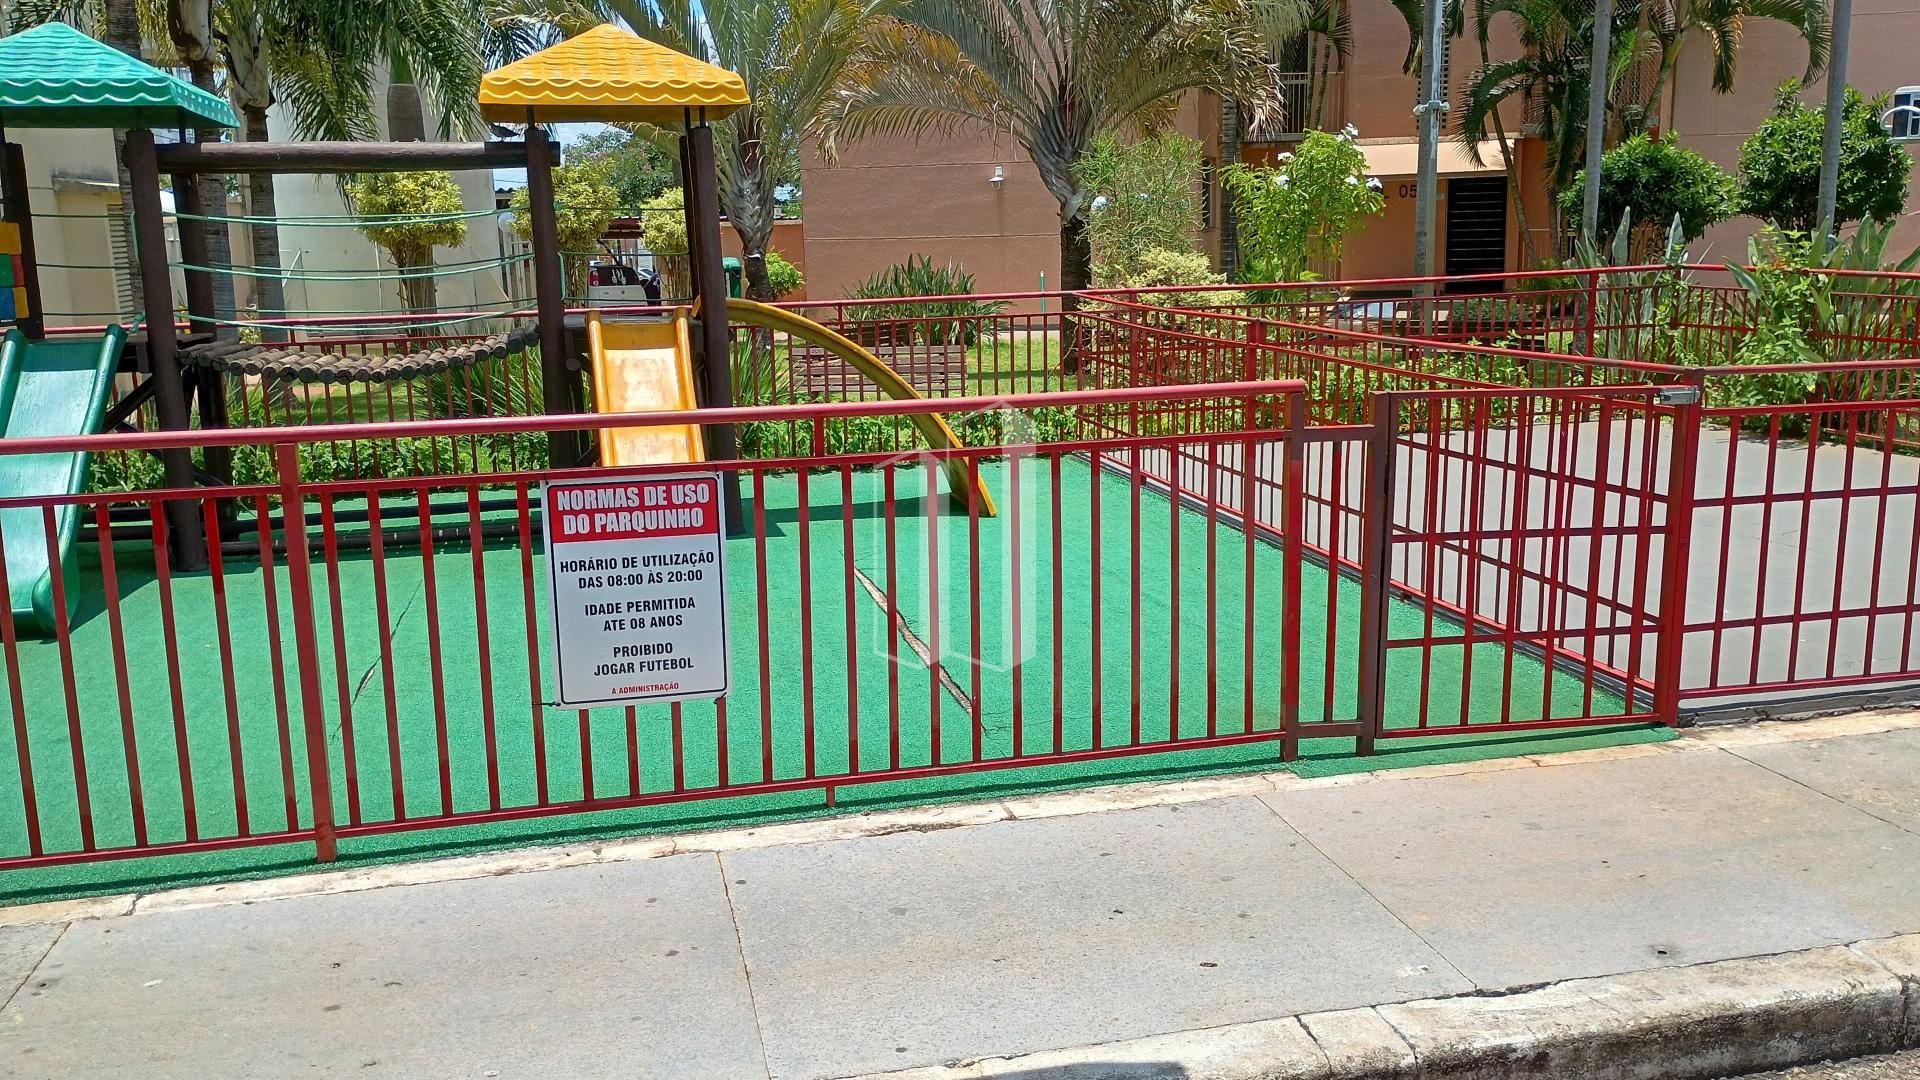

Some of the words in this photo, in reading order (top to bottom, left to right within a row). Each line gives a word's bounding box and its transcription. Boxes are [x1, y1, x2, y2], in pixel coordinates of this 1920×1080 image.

[557, 487, 639, 511] NORMAS
[645, 485, 667, 506] DE
[672, 484, 710, 504] USO
[563, 514, 589, 534] DO
[595, 508, 703, 532] PARQUINHO
[560, 557, 617, 572] HORÁRIO
[623, 556, 637, 568] DE
[643, 550, 714, 567] UTILIZAÇÃO
[579, 576, 603, 589] DAS
[608, 573, 643, 586] 08:00
[648, 571, 663, 584] ÀS
[668, 570, 703, 582] 20:00
[585, 602, 622, 616] IDADE
[627, 597, 695, 613] PERMITIDA
[604, 619, 626, 631] ATE
[631, 618, 645, 629] 08
[650, 615, 683, 628] ANOS
[614, 643, 673, 657] PROIBIDO
[594, 662, 635, 676] JOGAR
[640, 658, 694, 672] FUTEBOL
[619, 683, 679, 693] ADMINISTRAÇÃO
